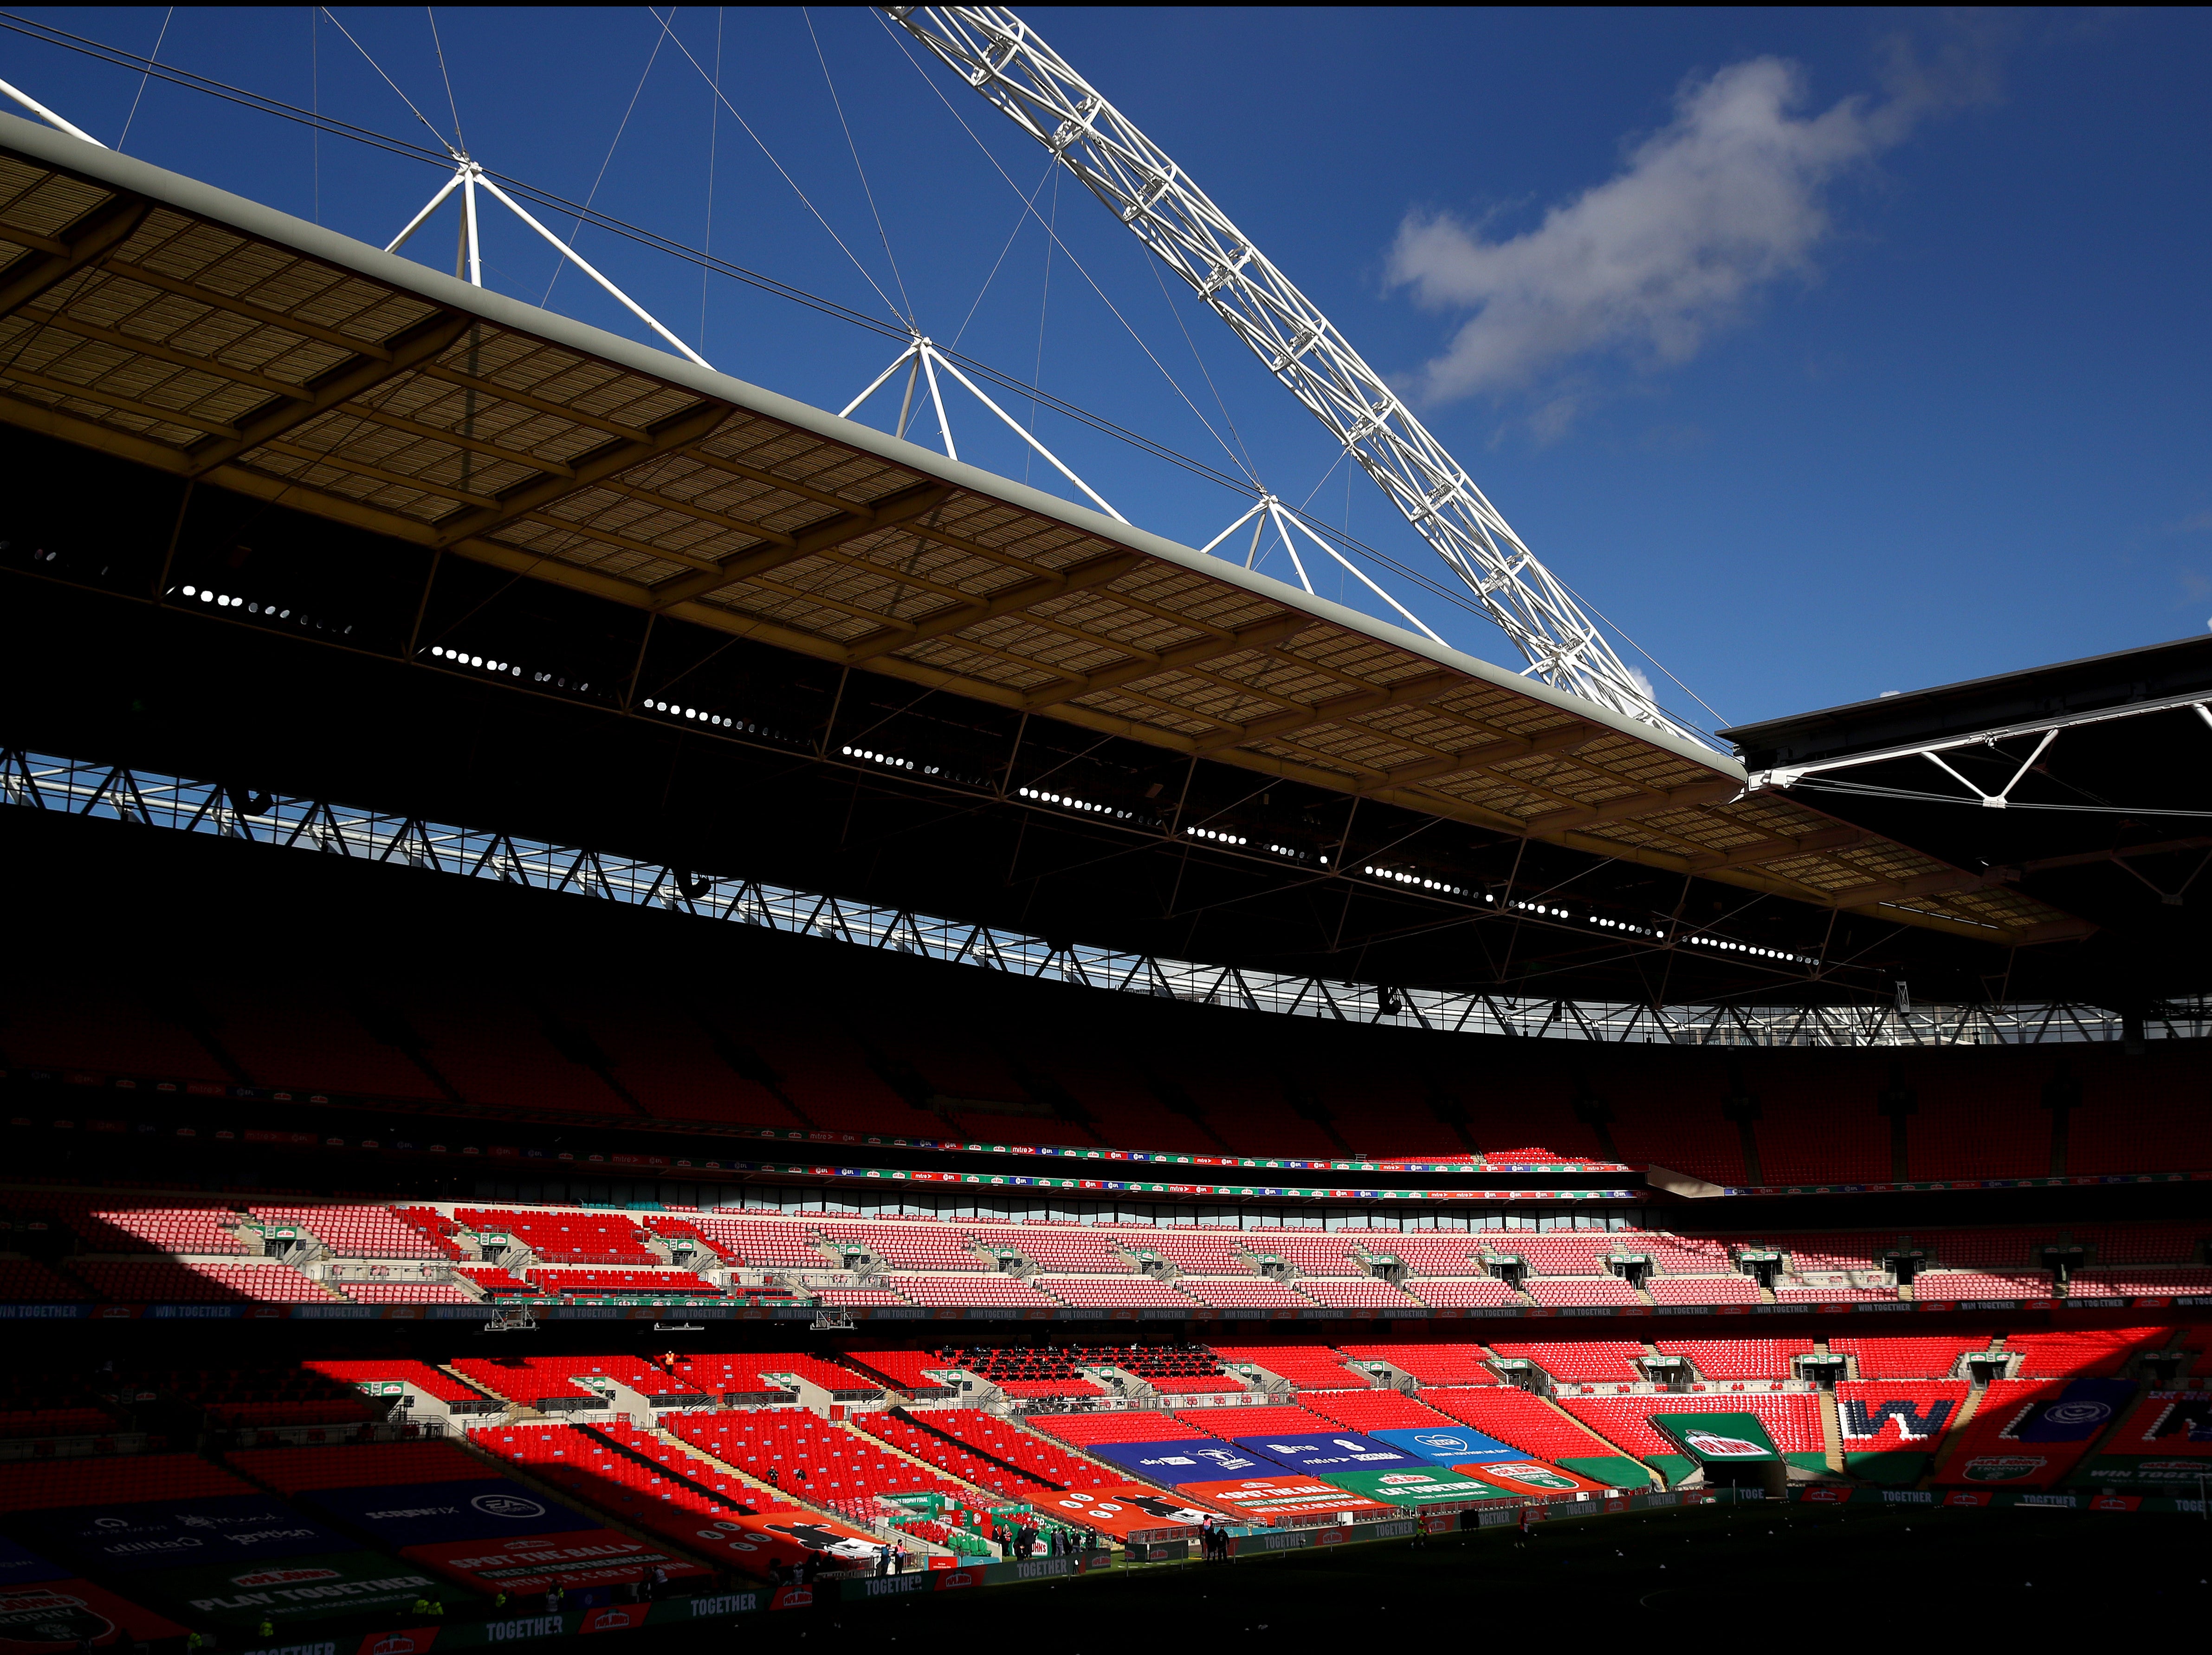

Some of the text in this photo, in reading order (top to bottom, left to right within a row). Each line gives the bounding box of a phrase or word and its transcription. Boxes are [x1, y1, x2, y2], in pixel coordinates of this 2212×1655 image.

[19, 1306, 77, 1317] TOGETHER
[156, 1306, 231, 1317] WIN TOGETHER
[303, 1307, 370, 1317] WIN TOGETHER
[437, 1307, 453, 1318] WIN
[559, 1308, 617, 1318] WIN TOGETHER
[672, 1309, 726, 1318] WIN TOGETHER
[778, 1310, 791, 1318] WIN
[877, 1310, 925, 1318] WIN TOGETHER
[970, 1310, 1016, 1318] WIN TOGETHER
[1485, 1309, 1517, 1317] TOGETHER
[1225, 1485, 1339, 1499] SPOT THE BALL
[1375, 1486, 1411, 1495] EAT
[1404, 1481, 1488, 1493] TOGETHER
[1648, 1493, 1676, 1506] TOGETHER
[1882, 1491, 1932, 1504] TOGETHER
[1566, 1502, 1597, 1515] TOGETHER
[1375, 1521, 1413, 1537] TOGETHER
[449, 1554, 517, 1569] SPOT
[512, 1551, 569, 1562] THE
[562, 1545, 629, 1558] BALL
[1017, 1558, 1067, 1578] TOGETHER
[189, 1592, 276, 1611] PLAY
[272, 1575, 435, 1602] TOGETHER
[691, 1593, 756, 1617] TOGETHER
[486, 1615, 563, 1642] TOGETHER
